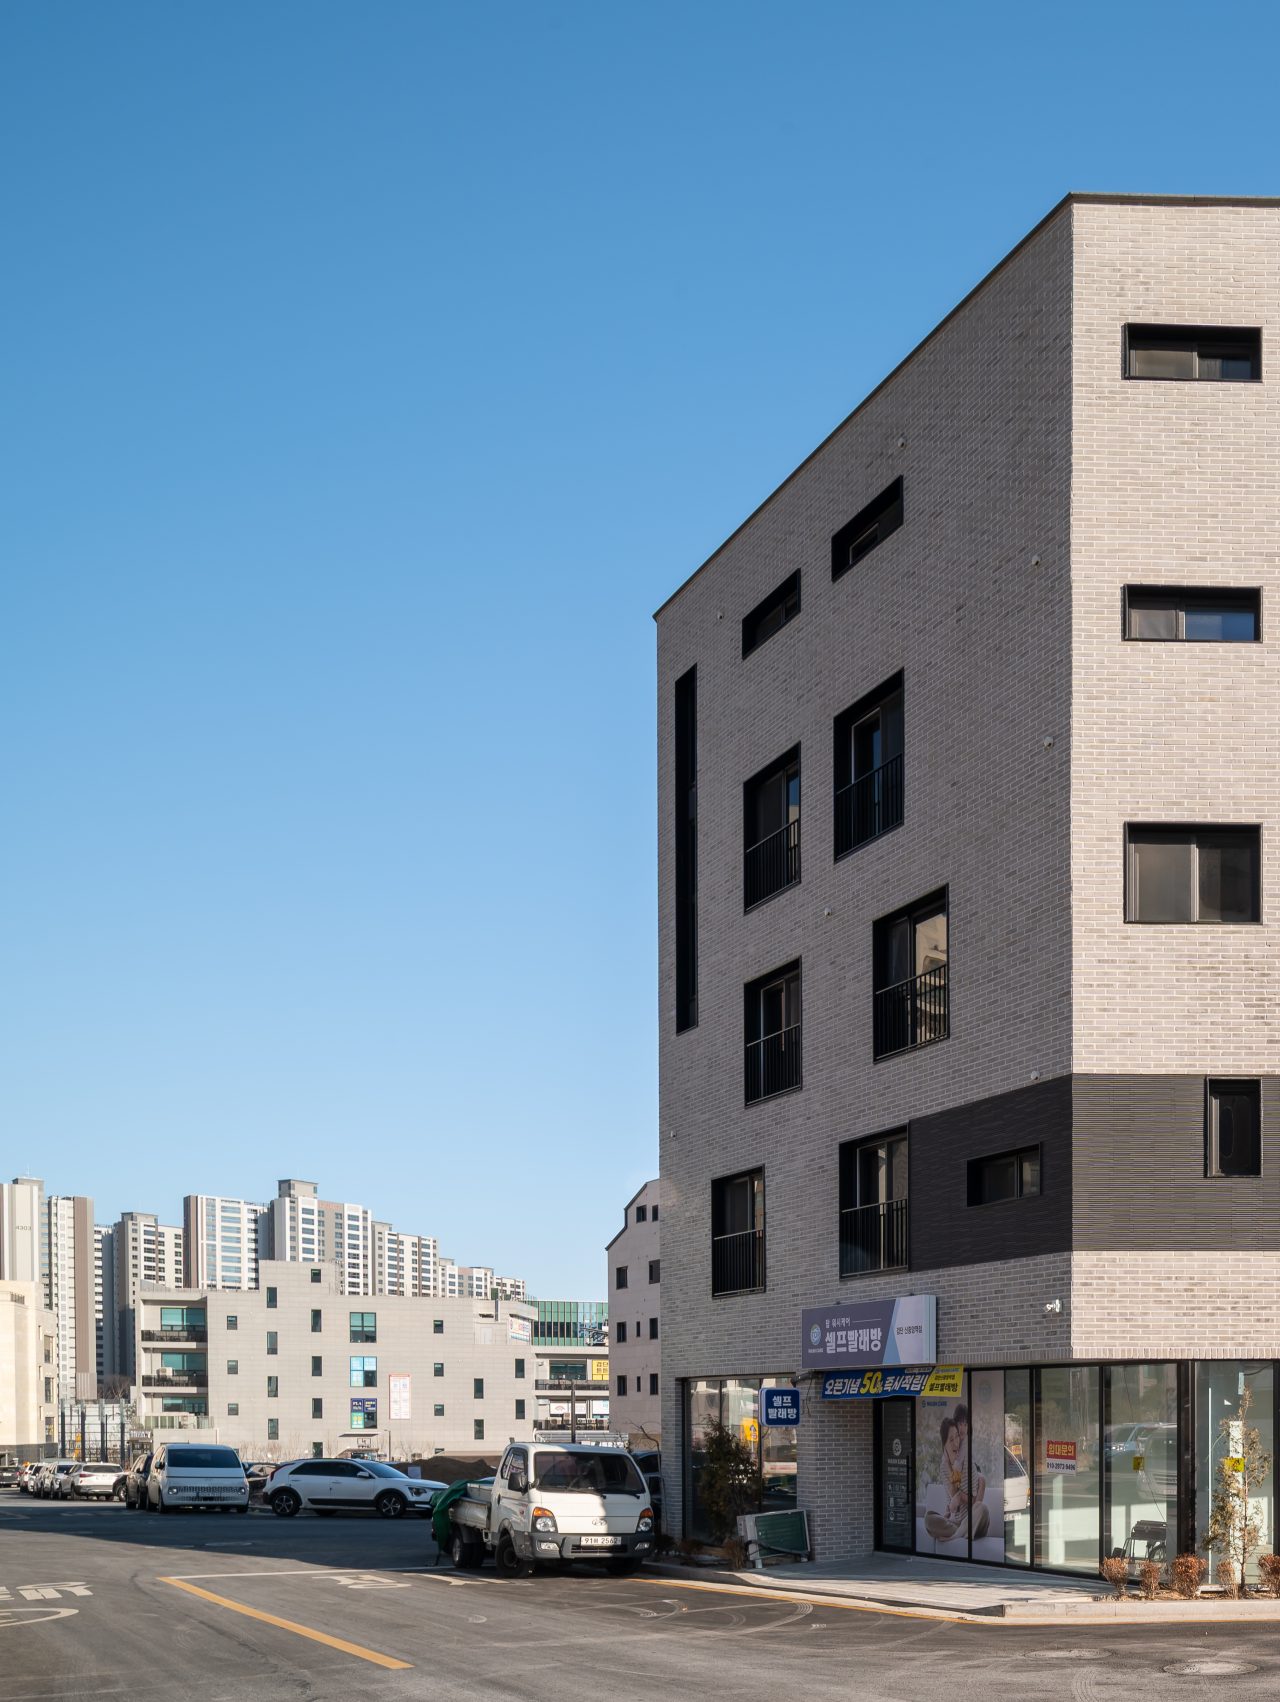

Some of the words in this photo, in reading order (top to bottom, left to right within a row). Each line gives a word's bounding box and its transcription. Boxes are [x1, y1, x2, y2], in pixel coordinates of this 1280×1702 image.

[825, 1328, 882, 1353] 셀프빨래방
[825, 1378, 861, 1395] 오픈기념
[860, 1371, 884, 1394] 50%
[929, 1383, 958, 1392] 셀프빨래방
[772, 1395, 792, 1406] 셀프
[768, 1408, 797, 1419] 빨래방
[1049, 1444, 1075, 1456] 임대문의
